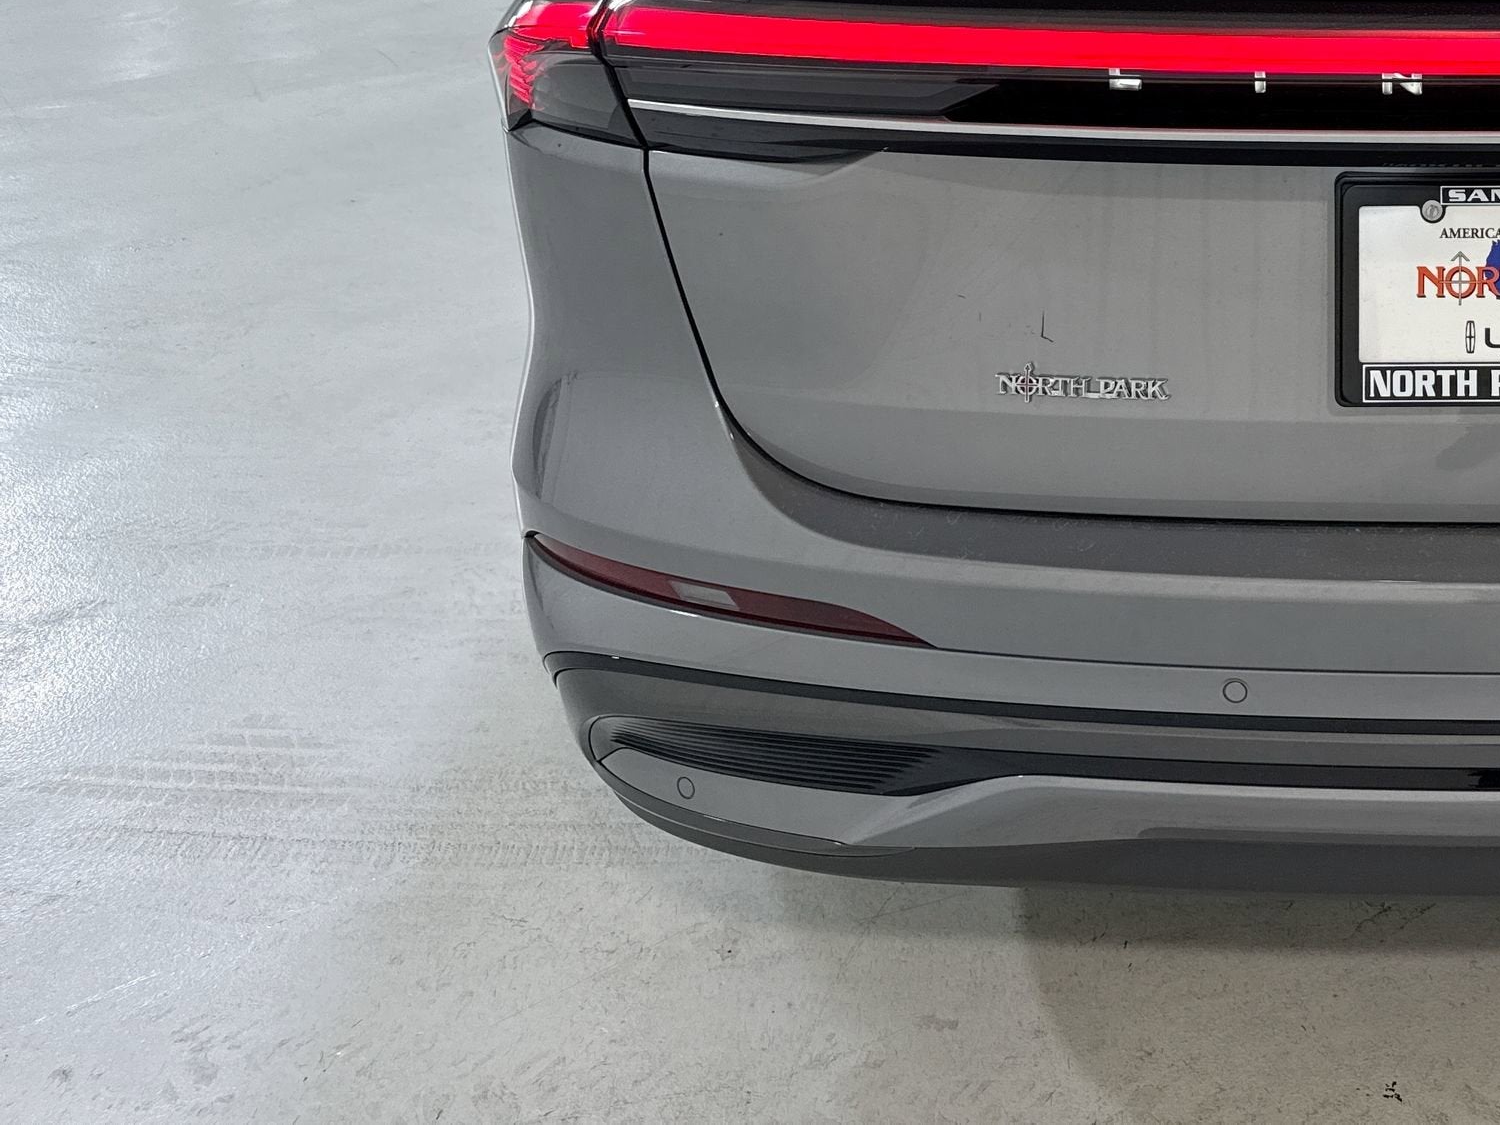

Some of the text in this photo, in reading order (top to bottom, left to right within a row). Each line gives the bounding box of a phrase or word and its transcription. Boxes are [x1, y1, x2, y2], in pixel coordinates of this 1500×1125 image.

[995, 373, 1170, 401] NORTH PARK
[1369, 369, 1478, 397] NORTH
